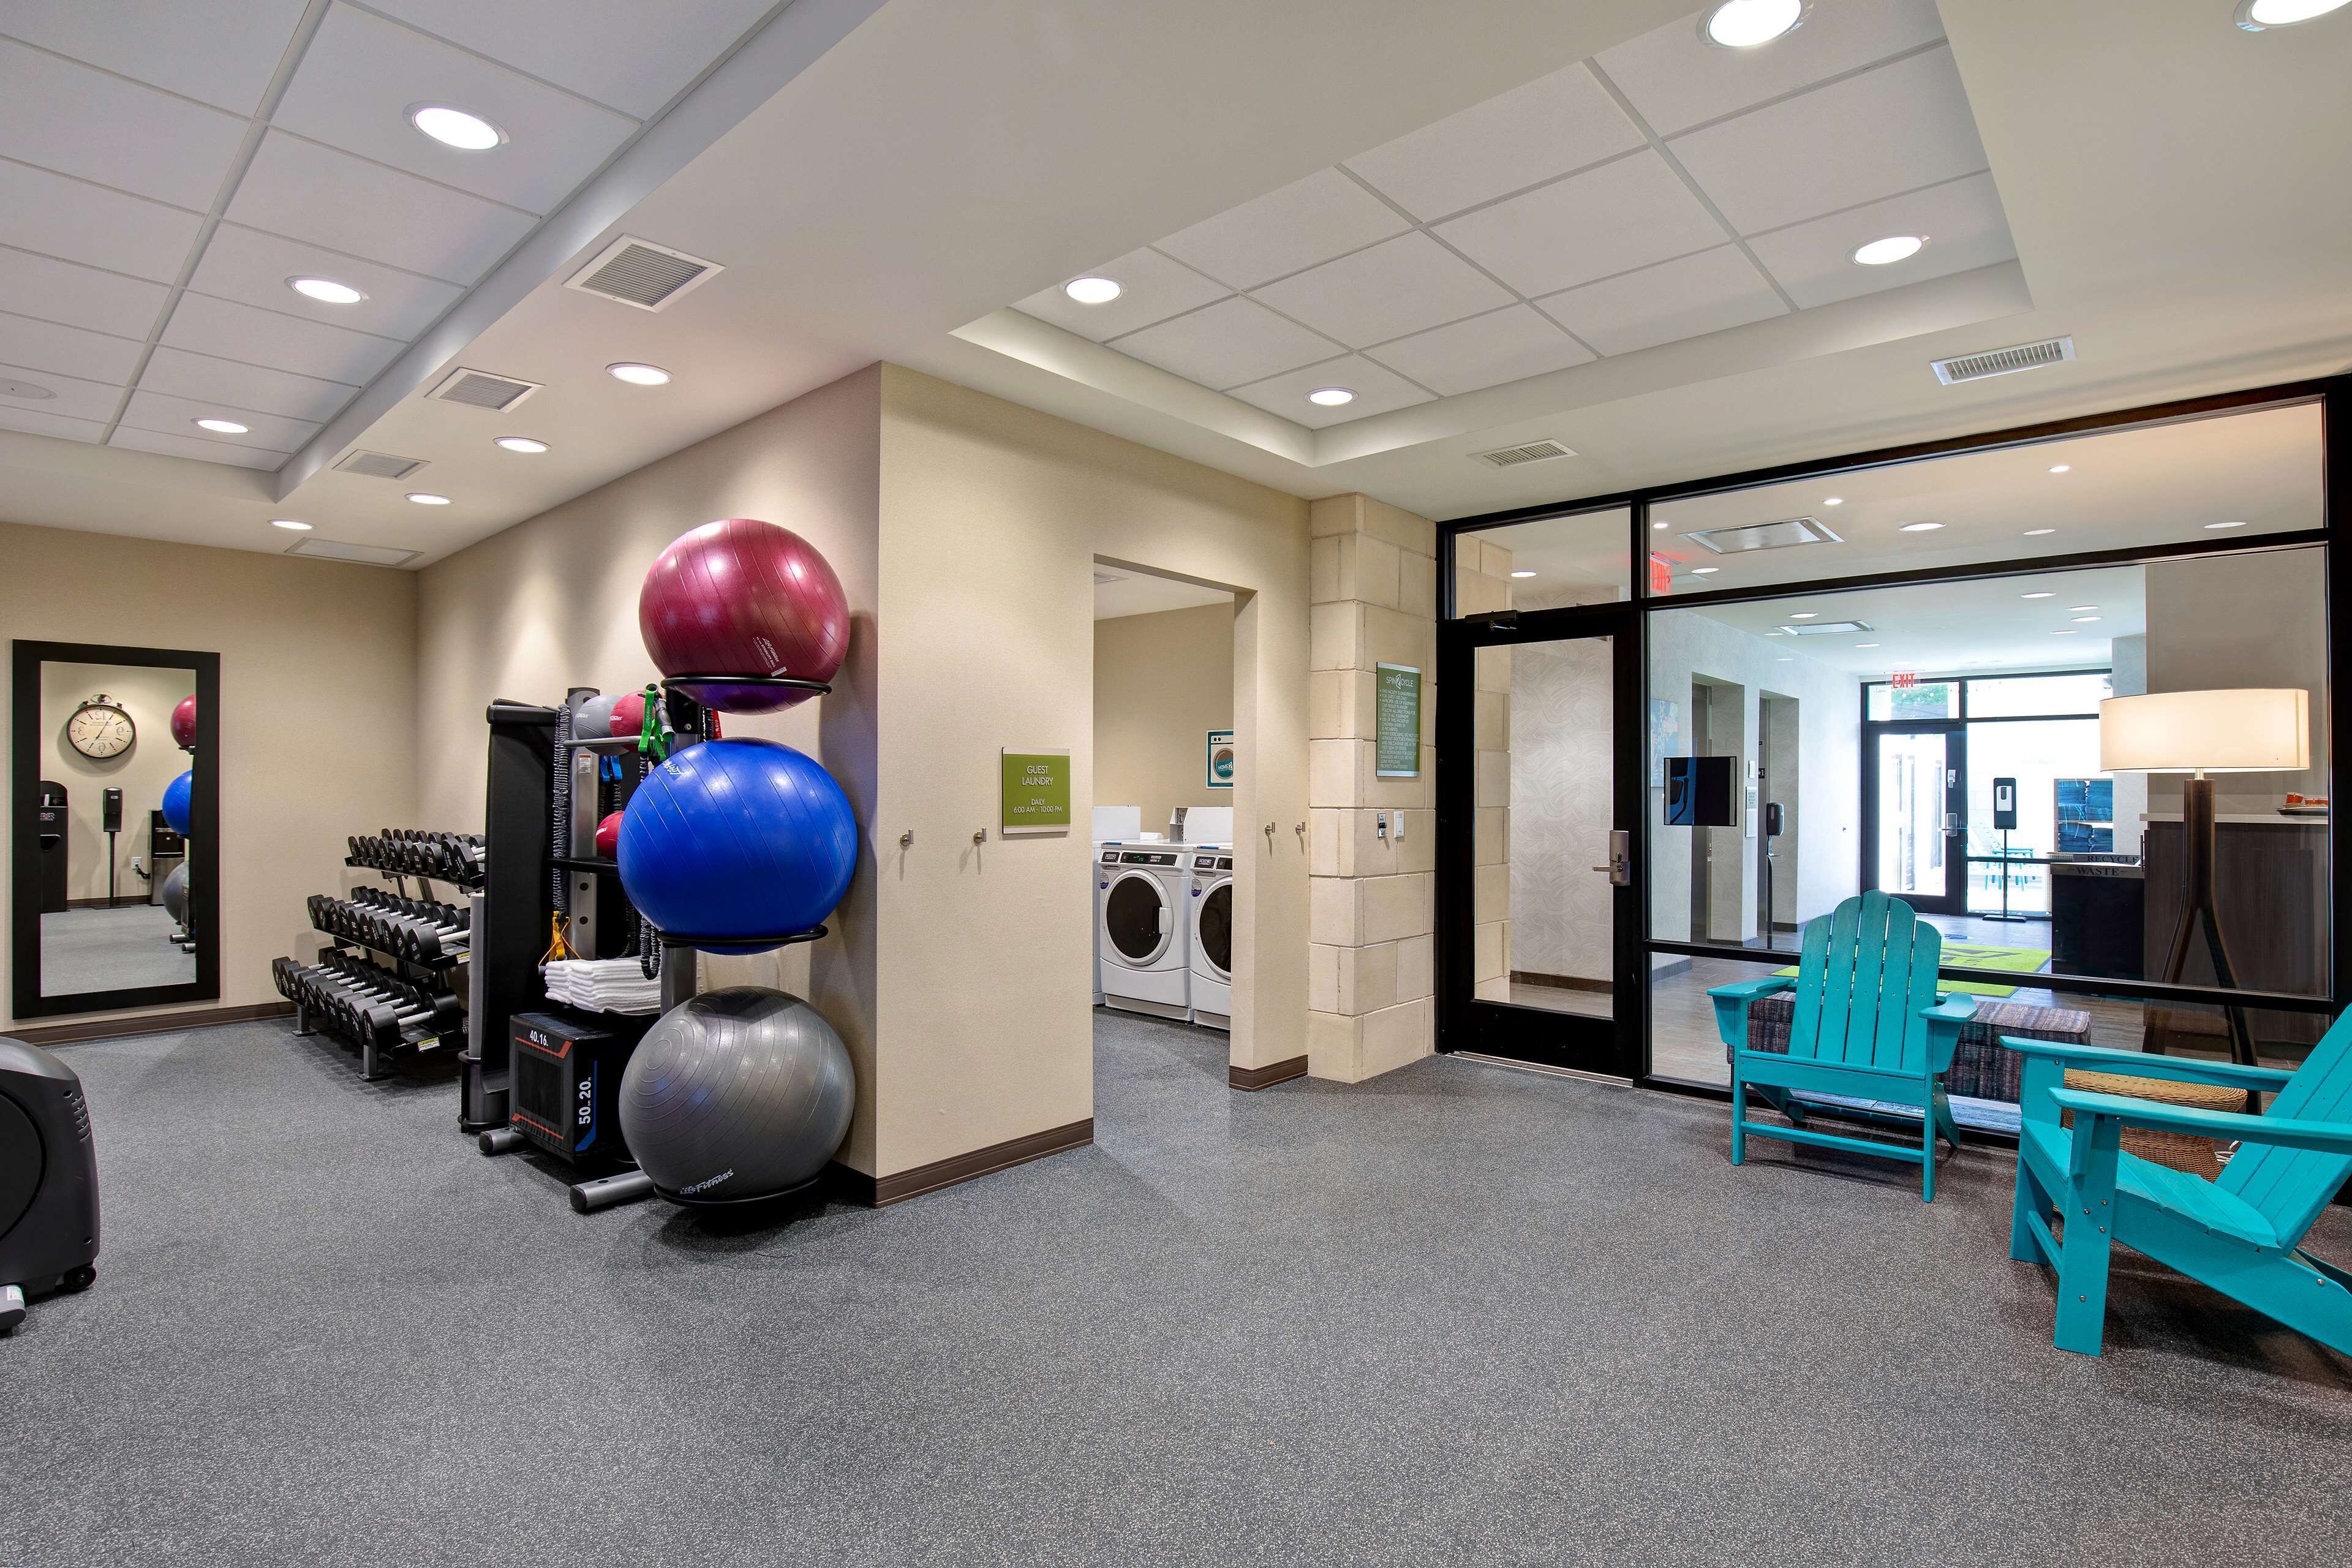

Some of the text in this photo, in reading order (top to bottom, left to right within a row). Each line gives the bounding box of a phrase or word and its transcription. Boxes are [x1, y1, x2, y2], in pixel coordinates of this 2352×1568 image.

[1651, 560, 1666, 592] EXIT
[1386, 676, 1396, 685] SPIN
[1401, 678, 1414, 687] CYCLE
[1893, 673, 1915, 688] EXIT
[1027, 766, 1049, 774] GUEST
[1022, 777, 1054, 786] LAUNDRY
[2076, 867, 2119, 876] WASTE
[579, 1081, 592, 1099] 20
[578, 1106, 591, 1125] 50
